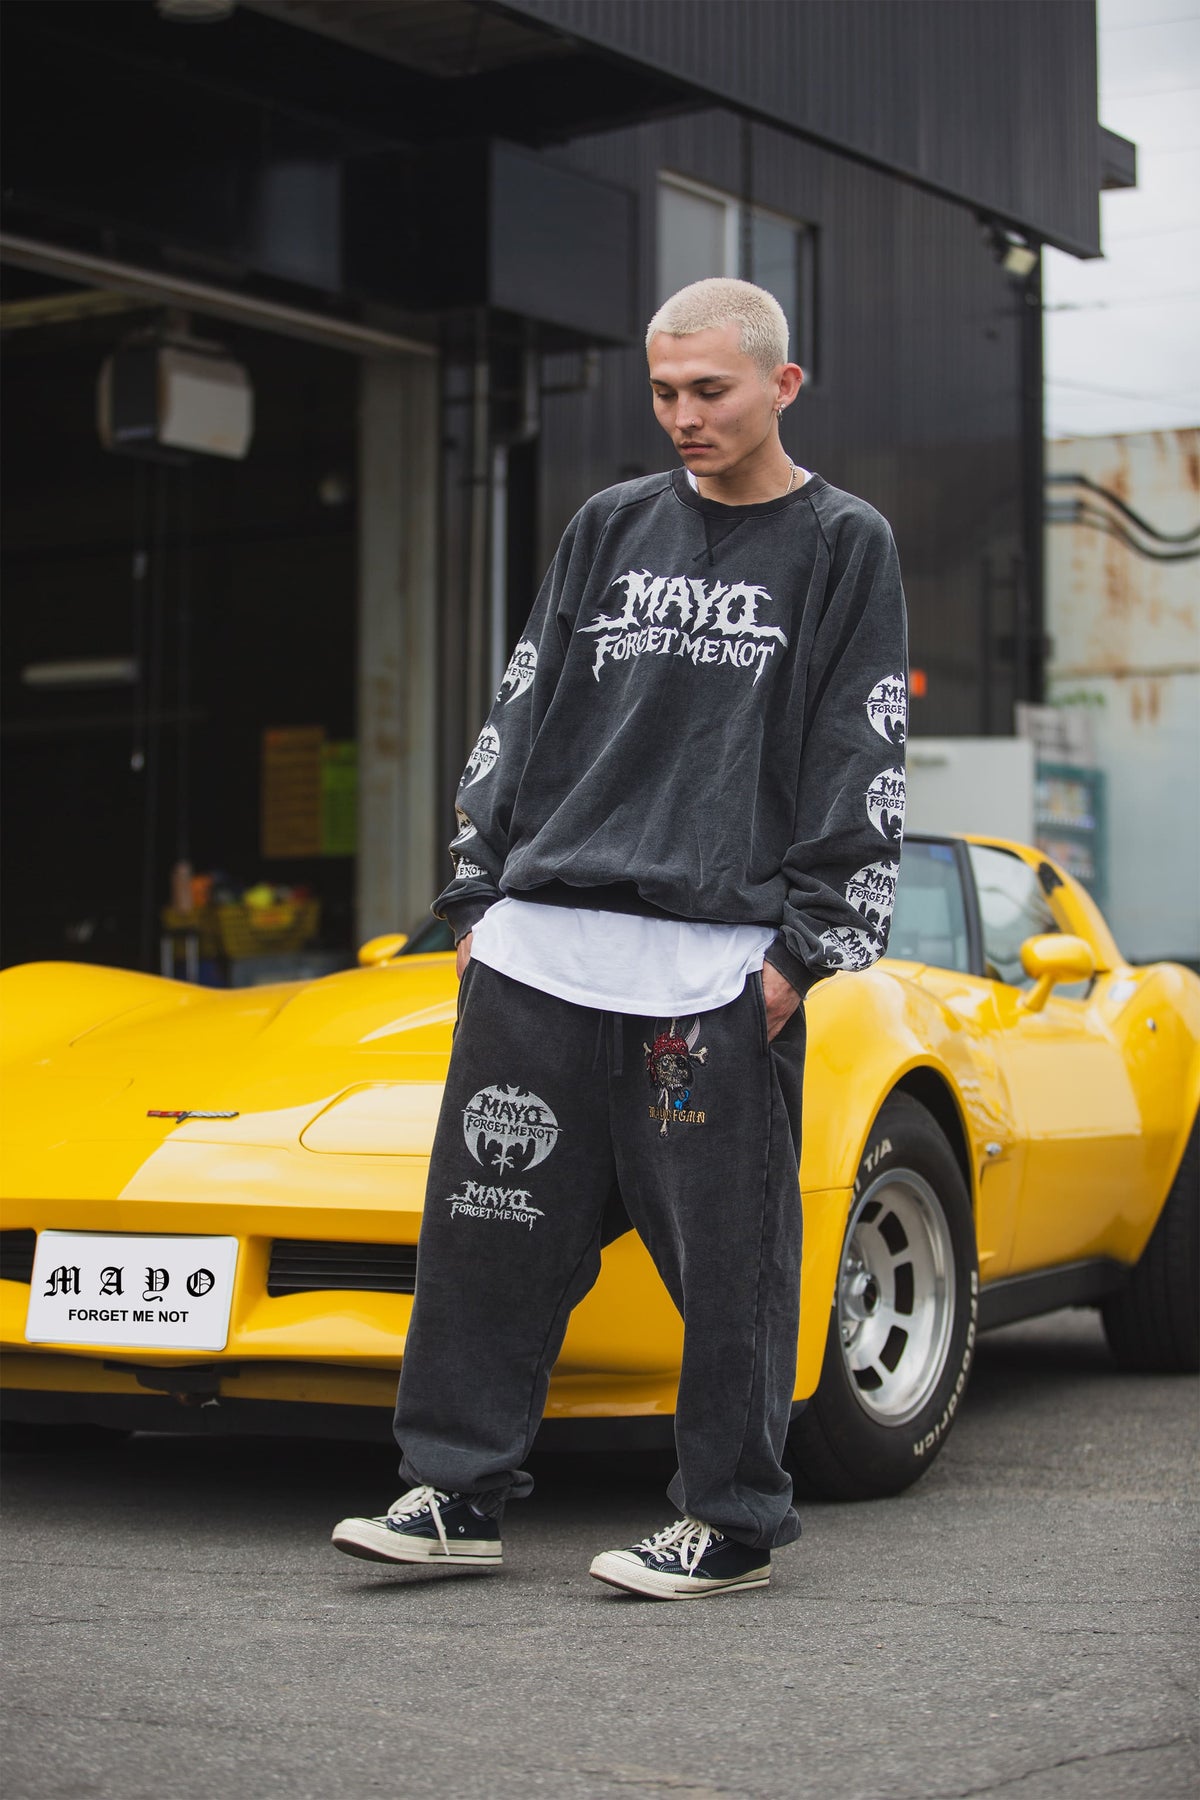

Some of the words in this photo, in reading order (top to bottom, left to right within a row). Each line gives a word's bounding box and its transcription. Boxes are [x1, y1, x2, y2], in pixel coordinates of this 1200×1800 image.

[577, 568, 789, 648] MAYO
[592, 626, 679, 682] FORGET
[849, 886, 888, 905] FORGET
[465, 1093, 558, 1127] MAYO
[466, 1115, 508, 1134] FORGET
[863, 1137, 893, 1173] T/A
[445, 1180, 545, 1215] MAYO
[450, 1201, 493, 1219] FORGET
[68, 1309, 129, 1321] FORGET
[132, 1310, 154, 1322] ME
[158, 1311, 189, 1323] NOT
